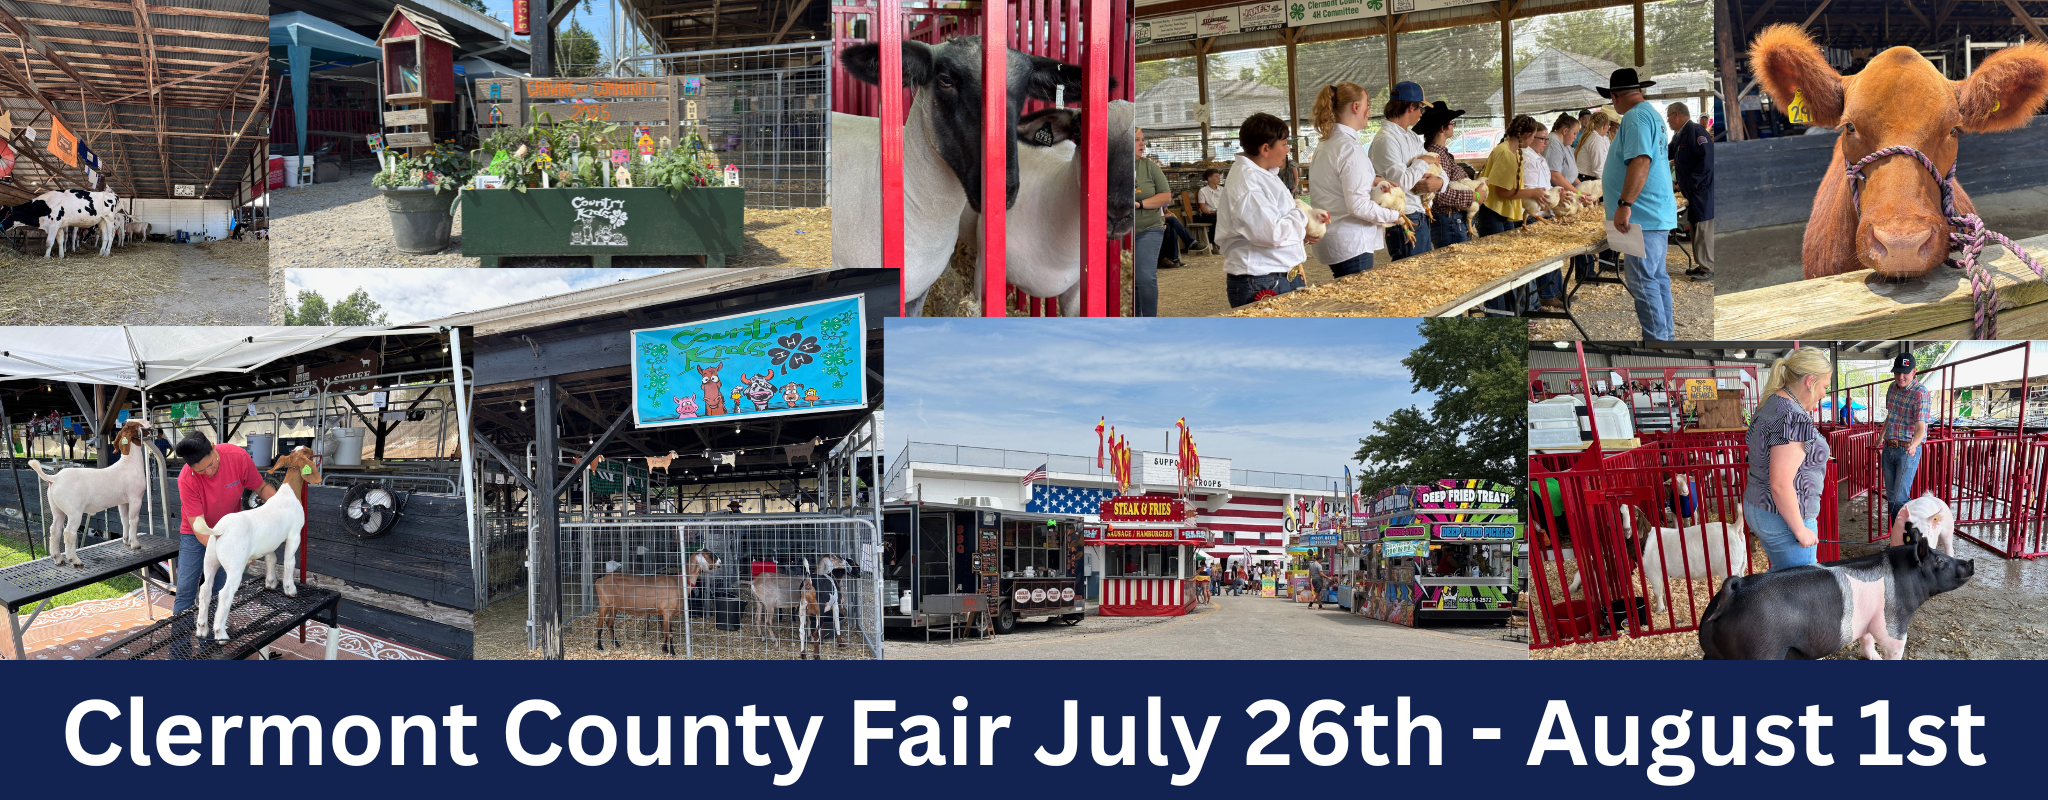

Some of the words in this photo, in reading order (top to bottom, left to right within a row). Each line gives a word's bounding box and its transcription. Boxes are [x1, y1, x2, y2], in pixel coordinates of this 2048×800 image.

[1243, 4, 1271, 17] JAKE'S
[1308, 0, 1338, 9] Clermont
[1312, 10, 1322, 19] 4H
[1323, 7, 1360, 18] Committee
[526, 80, 576, 97] GROWING
[577, 85, 588, 93] MY
[594, 80, 657, 96] COMMUNITY
[571, 104, 611, 121] 2025
[1790, 105, 1811, 123] 29
[571, 196, 626, 210] Country
[573, 208, 612, 222] Kids
[671, 315, 808, 349] Country
[678, 341, 772, 376] Kids
[1154, 457, 1178, 467] SUPPO
[1194, 478, 1222, 488] TROOPS
[1422, 491, 1447, 503] DEEP
[1448, 489, 1476, 503] FRIED
[1477, 489, 1510, 504] TREATS
[1113, 502, 1139, 516] STEAK
[1141, 502, 1147, 516] &
[1149, 502, 1171, 516] FRIES
[1136, 530, 1173, 538] HAMBURGERS
[1406, 526, 1425, 536] STICKS
[1441, 527, 1461, 538] DEEP
[1461, 527, 1483, 538] FRIED
[1484, 526, 1515, 538] PICKLES
